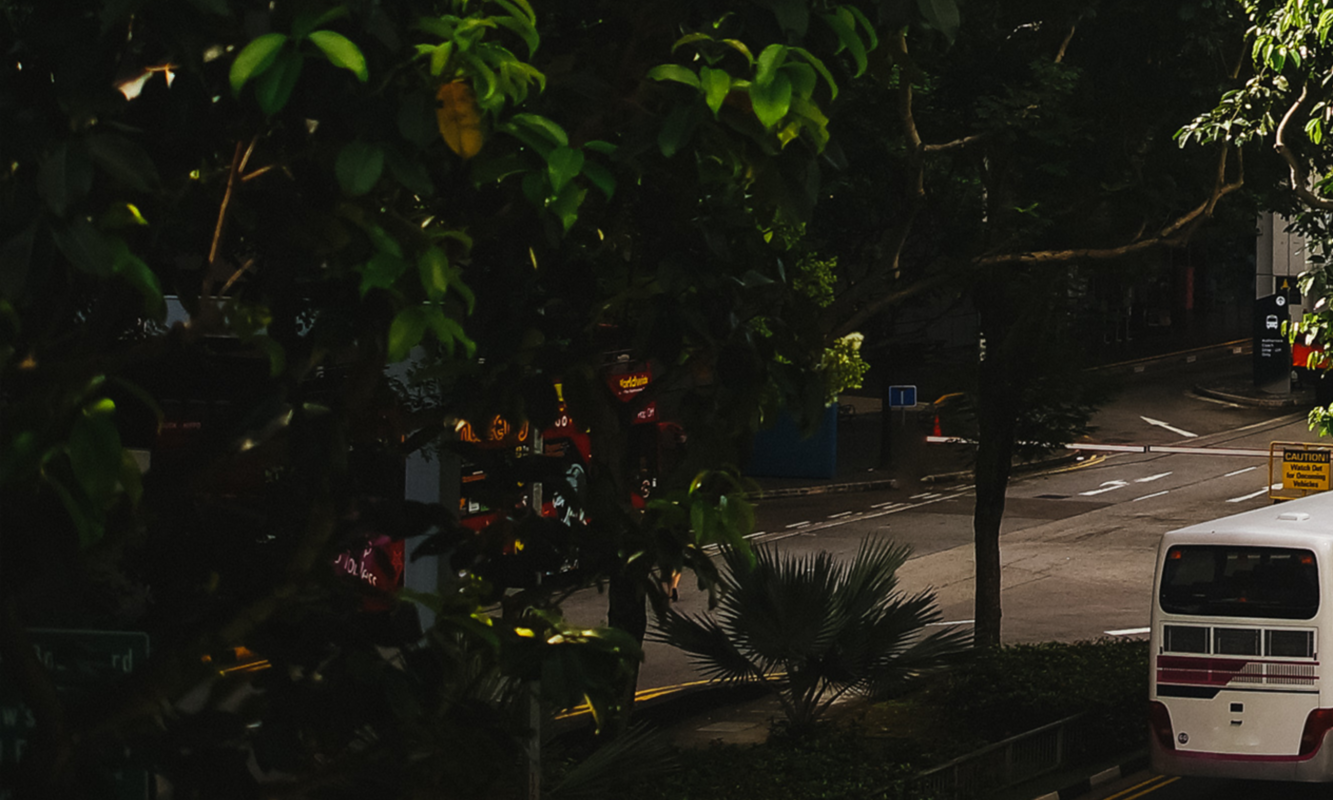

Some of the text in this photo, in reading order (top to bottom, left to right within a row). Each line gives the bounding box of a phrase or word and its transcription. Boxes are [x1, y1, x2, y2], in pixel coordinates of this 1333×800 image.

[1285, 452, 1329, 462] CAUTION!
[1312, 464, 1323, 472] Out
[1296, 472, 1326, 481] Oncoming
[1293, 480, 1319, 488] Vehicles
